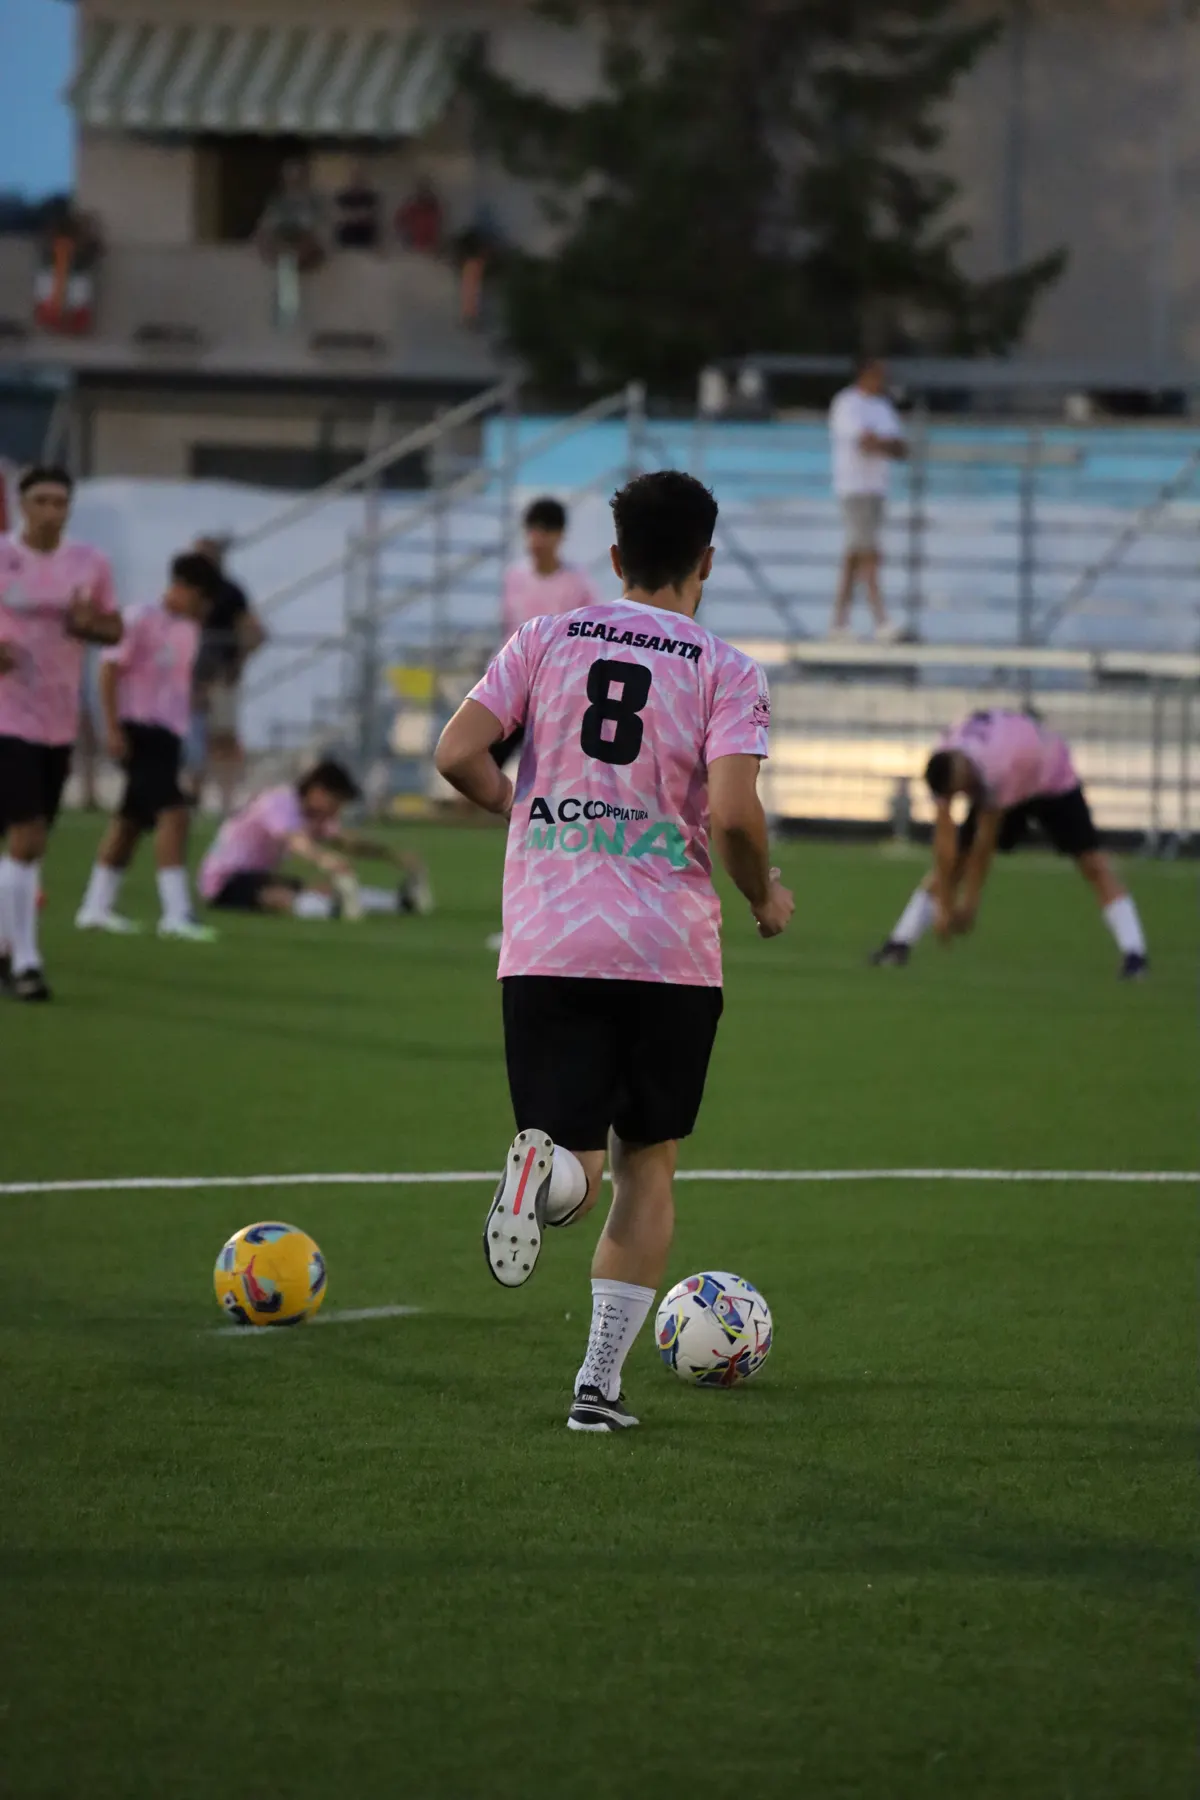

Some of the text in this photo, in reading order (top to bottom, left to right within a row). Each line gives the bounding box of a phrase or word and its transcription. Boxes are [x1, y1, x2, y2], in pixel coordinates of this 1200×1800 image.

[567, 621, 703, 664] SCALASANTA
[580, 658, 652, 766] 8
[529, 797, 649, 825] ACCOPPIATURA
[526, 821, 690, 867] MONA
[581, 1394, 598, 1402] KING
